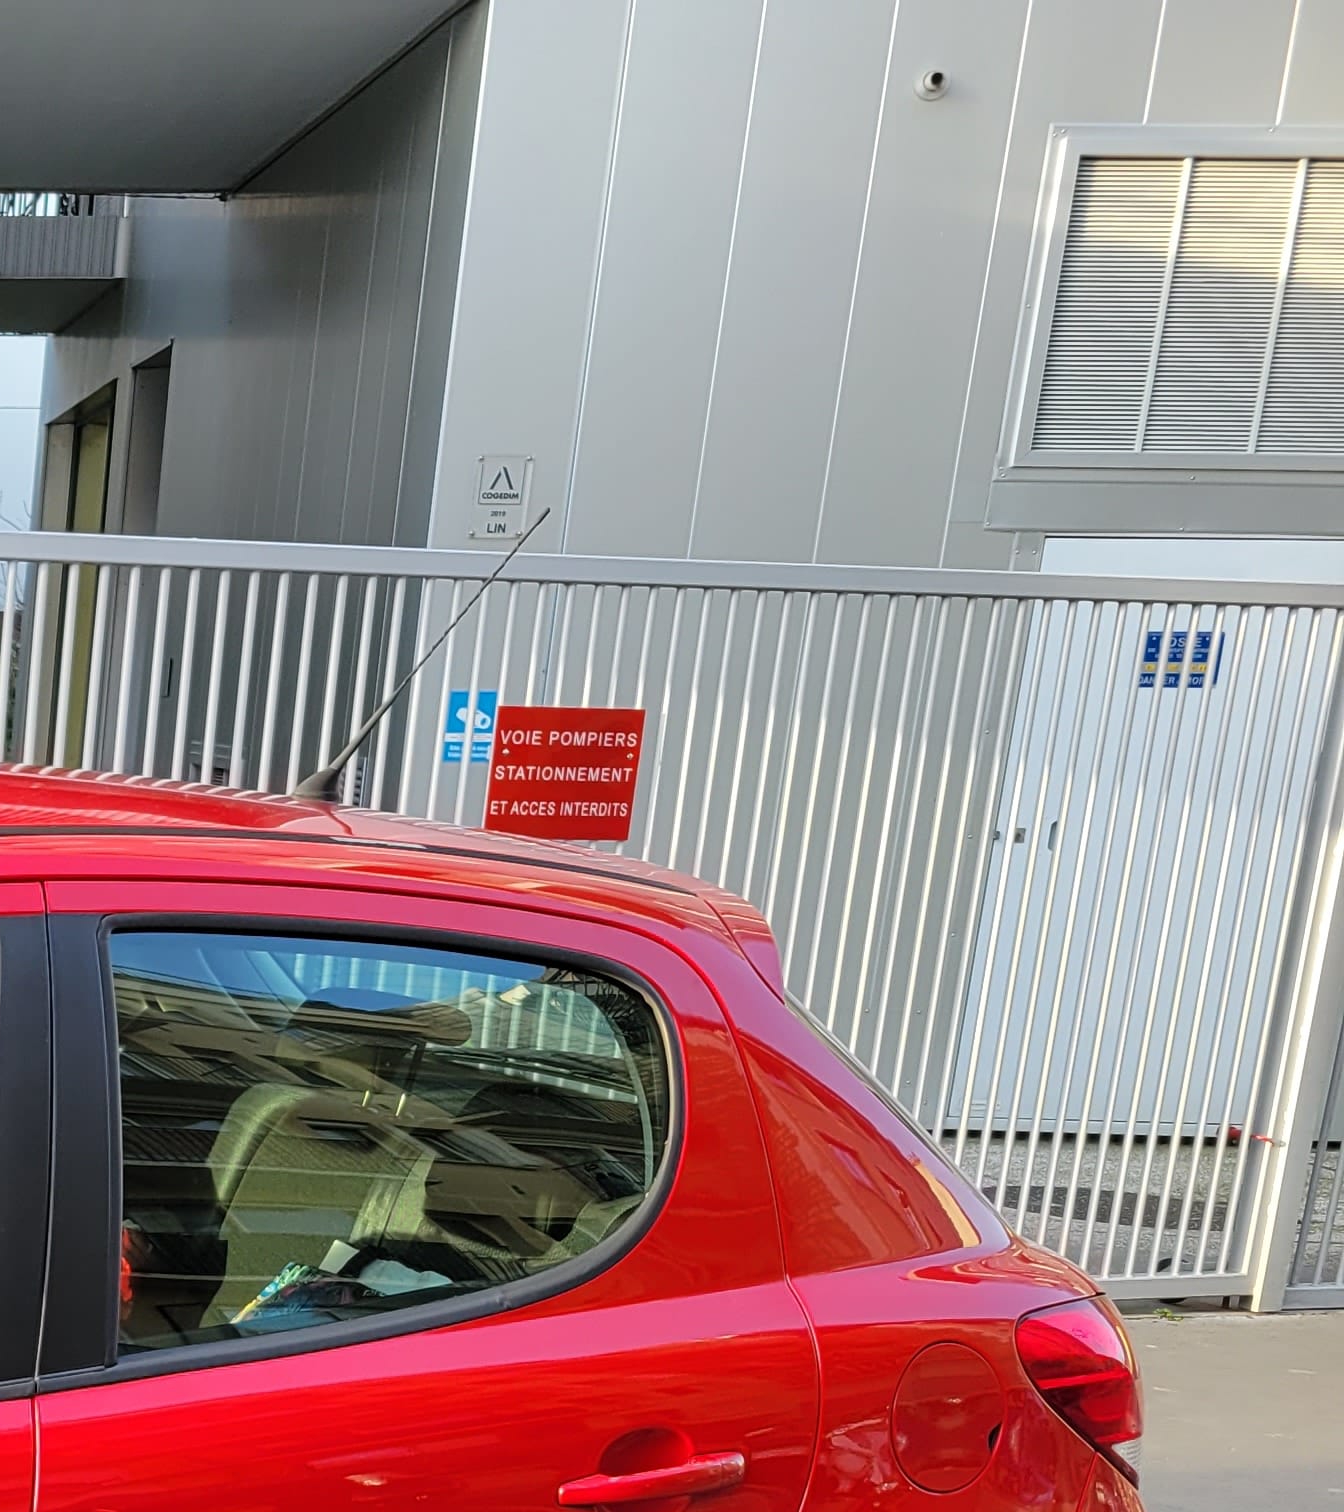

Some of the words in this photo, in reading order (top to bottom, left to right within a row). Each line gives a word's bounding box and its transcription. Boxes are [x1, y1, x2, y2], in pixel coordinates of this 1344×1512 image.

[482, 491, 519, 500] COGEDIM
[487, 523, 506, 533] LIN
[500, 730, 543, 746] VOIE
[549, 731, 638, 748] POMPIERS
[494, 765, 633, 782] STATIONNEMENT
[490, 800, 508, 815] ET
[510, 801, 556, 816] ACCES
[559, 802, 629, 817] INTERDITS
